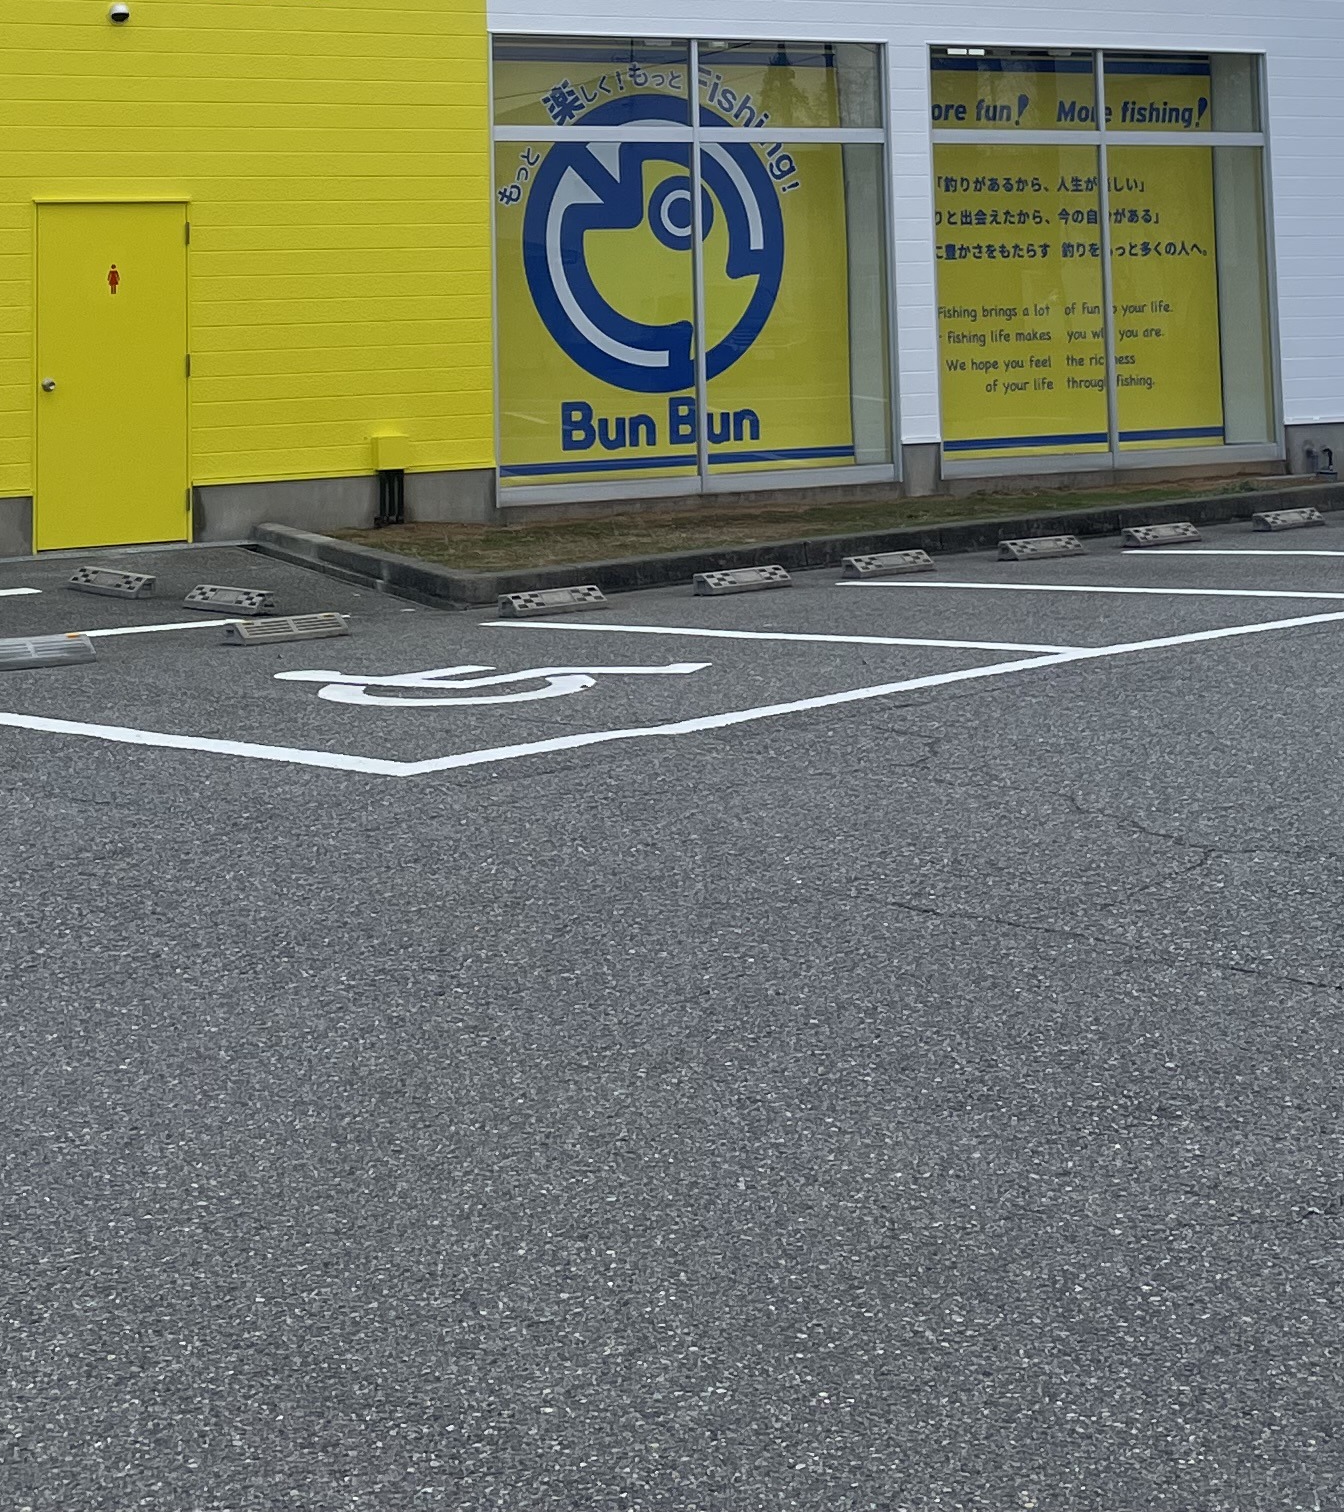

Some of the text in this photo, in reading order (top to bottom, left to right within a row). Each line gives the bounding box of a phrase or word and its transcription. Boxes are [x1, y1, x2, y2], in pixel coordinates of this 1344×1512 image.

[975, 94, 1029, 126] fun!
[1121, 97, 1208, 129] fishing!
[937, 306, 977, 322] Fishing
[982, 306, 1017, 321] brings
[1022, 307, 1030, 317] a
[1034, 304, 1050, 316] lot
[1064, 302, 1076, 316] of
[1082, 302, 1100, 315] fun
[1121, 304, 1147, 317] your
[1151, 300, 1173, 313] life.
[947, 330, 986, 347] fishing
[991, 329, 1011, 343] life
[1015, 329, 1052, 342] makes
[1067, 330, 1087, 343] you
[1119, 328, 1138, 342] you
[946, 353, 1136, 374] We hope you feel the ricness
[985, 378, 998, 393] of
[1002, 381, 1030, 395] your
[1033, 377, 1054, 390] life
